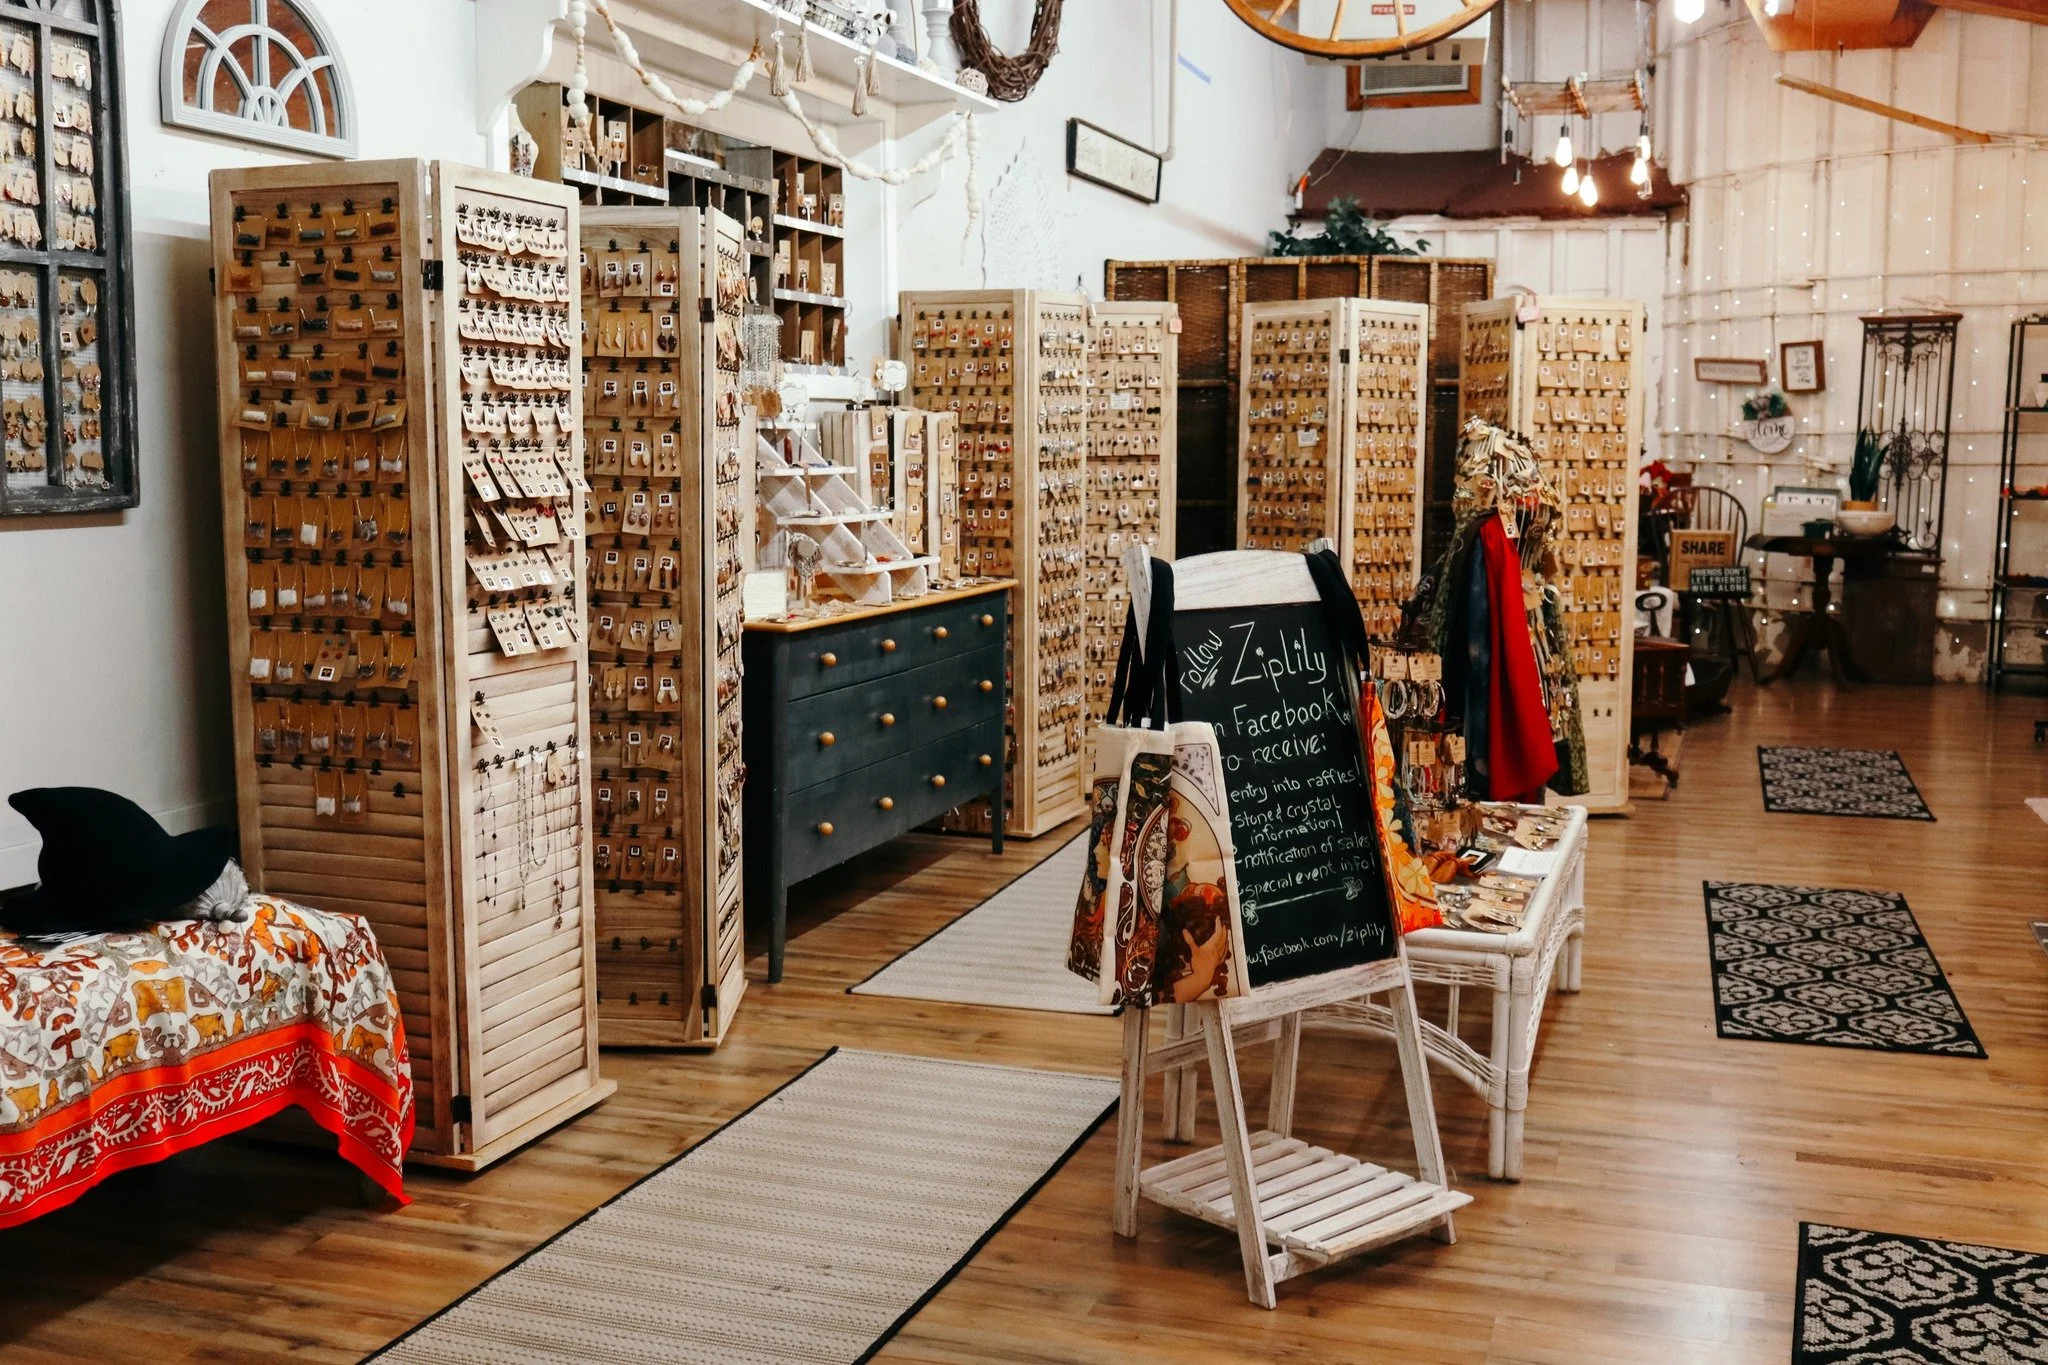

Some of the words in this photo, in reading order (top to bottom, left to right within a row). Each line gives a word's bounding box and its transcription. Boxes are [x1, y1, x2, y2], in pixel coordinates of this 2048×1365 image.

[1681, 541, 1725, 555] SHARE
[1691, 577, 1706, 585] LET
[1709, 577, 1747, 585] FRIENDS
[1724, 568, 1747, 576] DON'T
[1229, 621, 1327, 692] Ziplily
[1251, 732, 1327, 764] receive:
[1230, 782, 1268, 803] entry
[1272, 776, 1300, 793] into
[1307, 755, 1362, 788] raffles!
[1286, 794, 1341, 822] crystal
[1250, 810, 1344, 846] information!
[1244, 844, 1317, 869] notification
[1320, 836, 1335, 853] of
[1244, 873, 1292, 900] special
[1295, 860, 1337, 885] event
